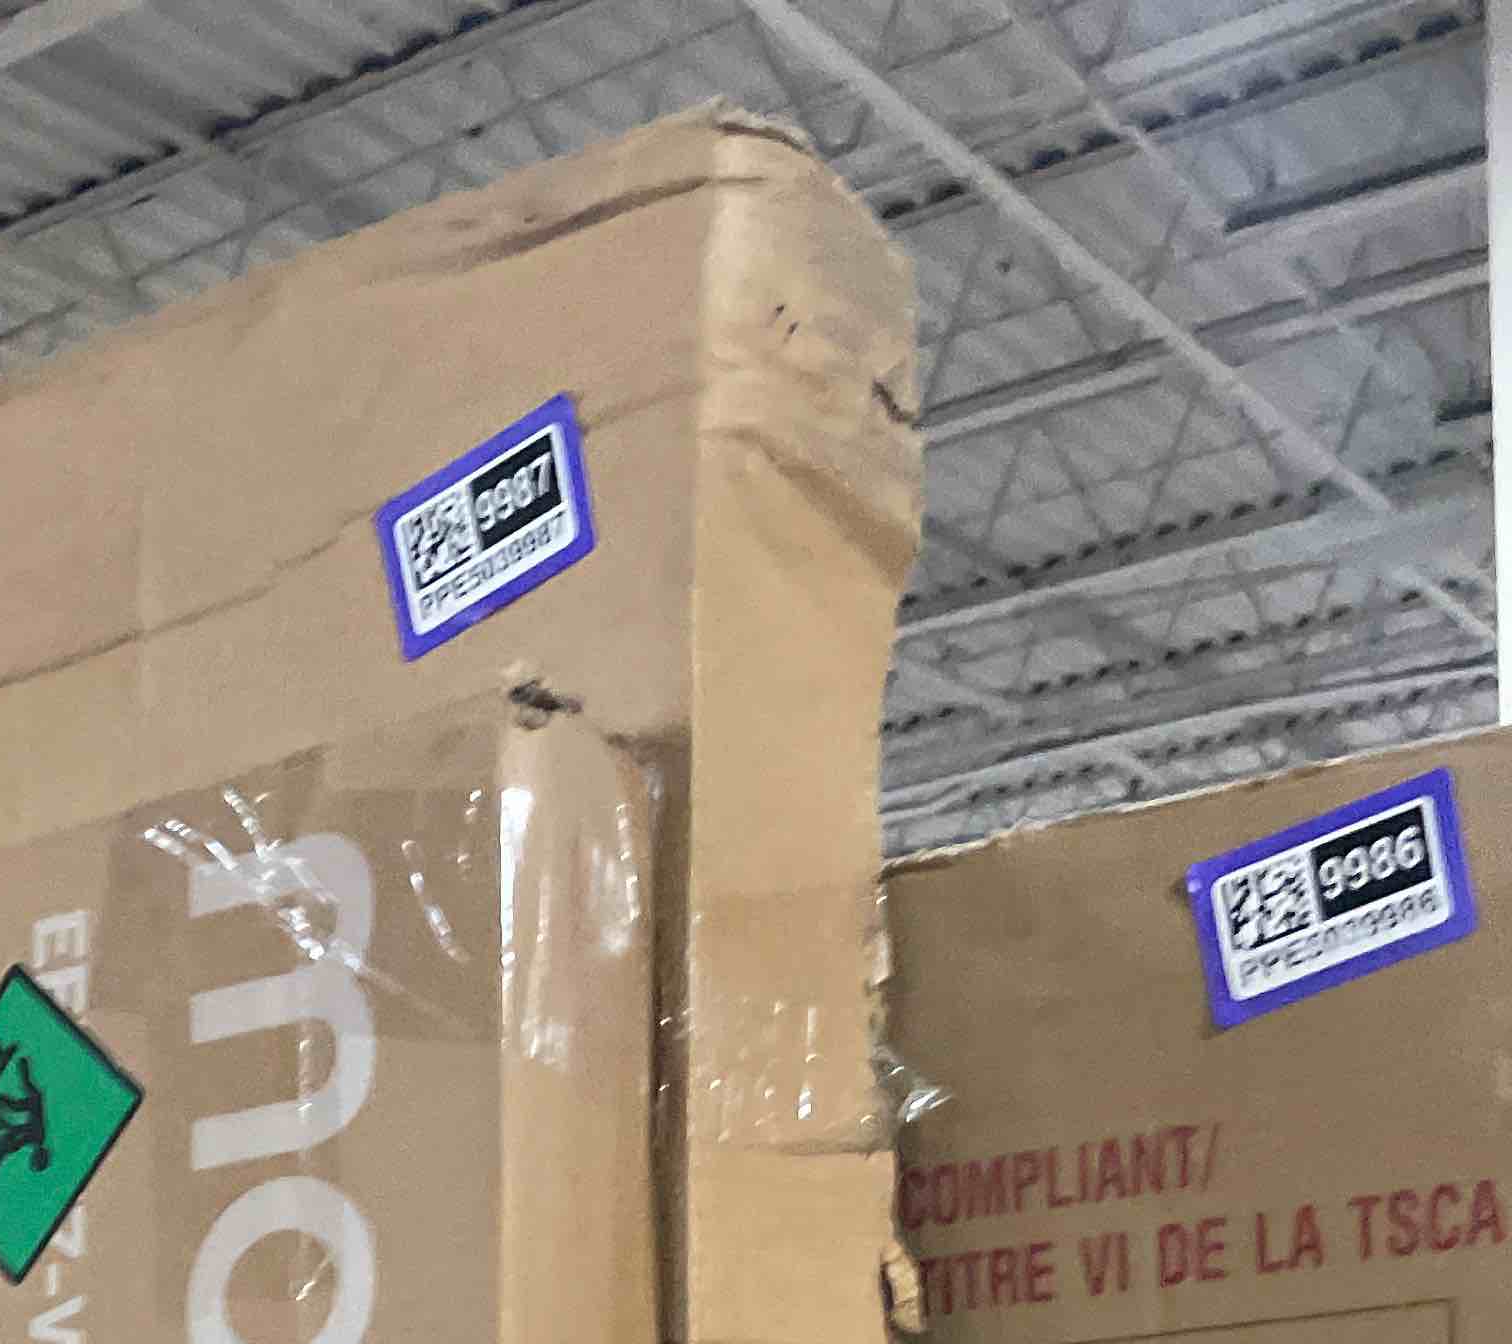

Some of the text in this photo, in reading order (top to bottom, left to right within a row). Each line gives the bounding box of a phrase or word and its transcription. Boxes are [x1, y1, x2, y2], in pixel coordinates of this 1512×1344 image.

[475, 451, 555, 533] 9987
[1318, 824, 1426, 900] 9986
[899, 1121, 1220, 1233] COMPLIANT/
[1078, 1231, 1131, 1298] VI
[1156, 1216, 1229, 1290] DE
[1254, 1203, 1325, 1276] LA
[1347, 1178, 1508, 1262] TSCA
